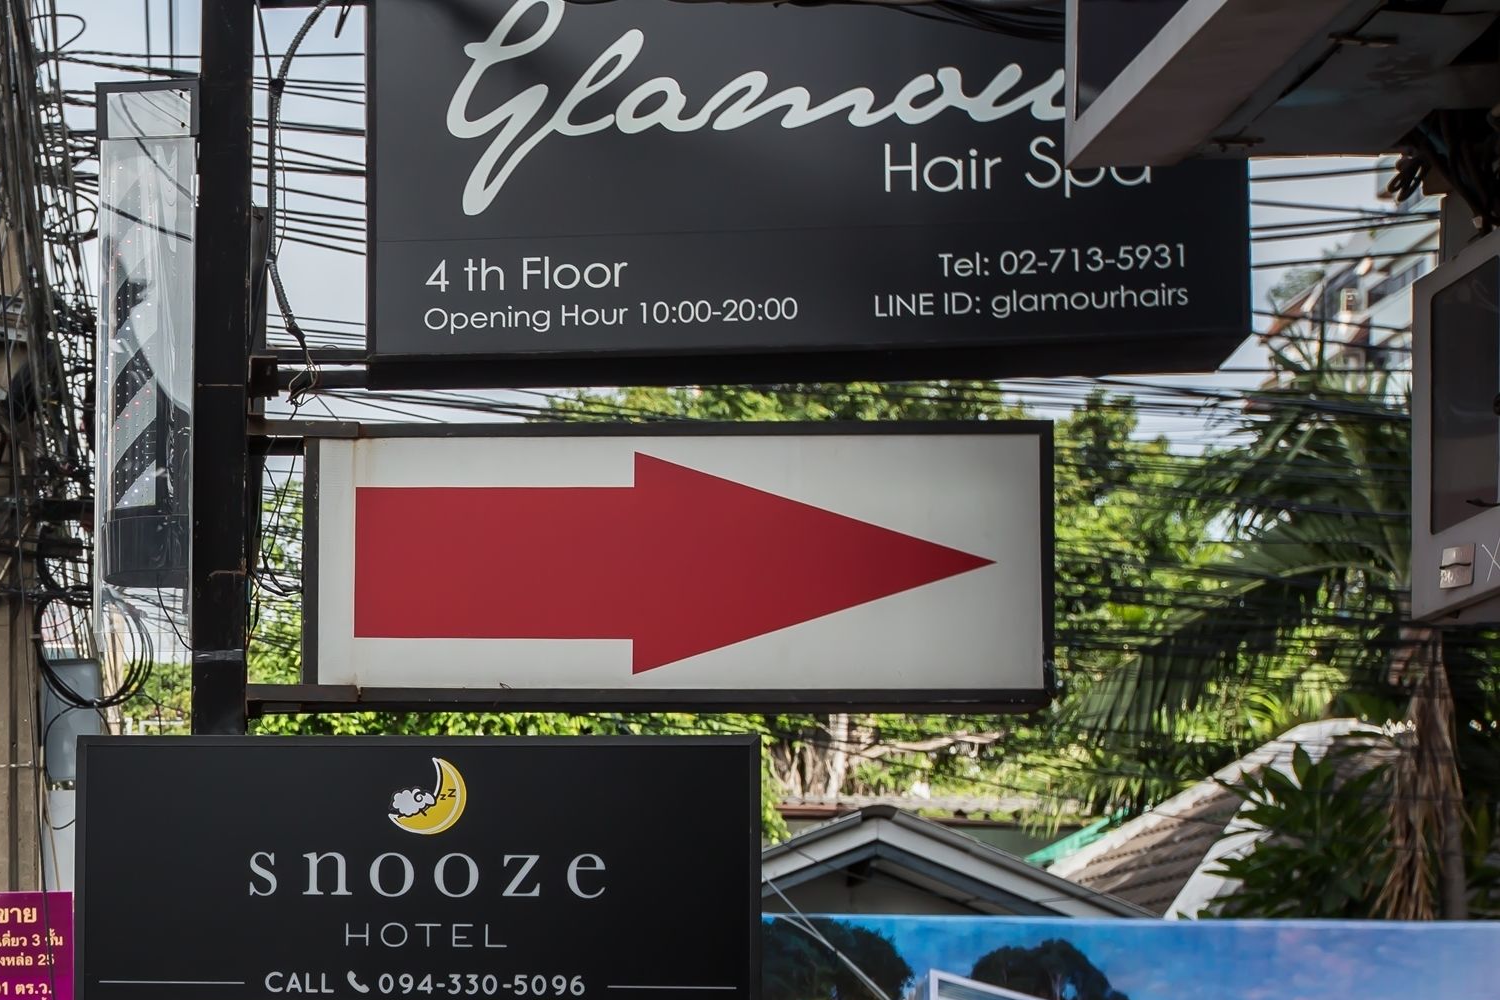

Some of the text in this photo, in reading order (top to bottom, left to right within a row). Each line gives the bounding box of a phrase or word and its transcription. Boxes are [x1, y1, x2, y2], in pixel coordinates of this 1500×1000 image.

[446, 0, 1066, 216] Glamou
[885, 142, 1002, 192] Hair
[425, 256, 628, 292] 4 th Floor
[938, 243, 1185, 277] Tel: 02-713-5931
[424, 297, 798, 334] Opening Hour 10:00-20:00
[874, 283, 1188, 318] LINE ID: glamourhairs
[249, 851, 606, 899] snooze
[32, 934, 41, 946] 3
[345, 922, 507, 948] HOTEL
[264, 972, 585, 996] CALL 094-330-5096
